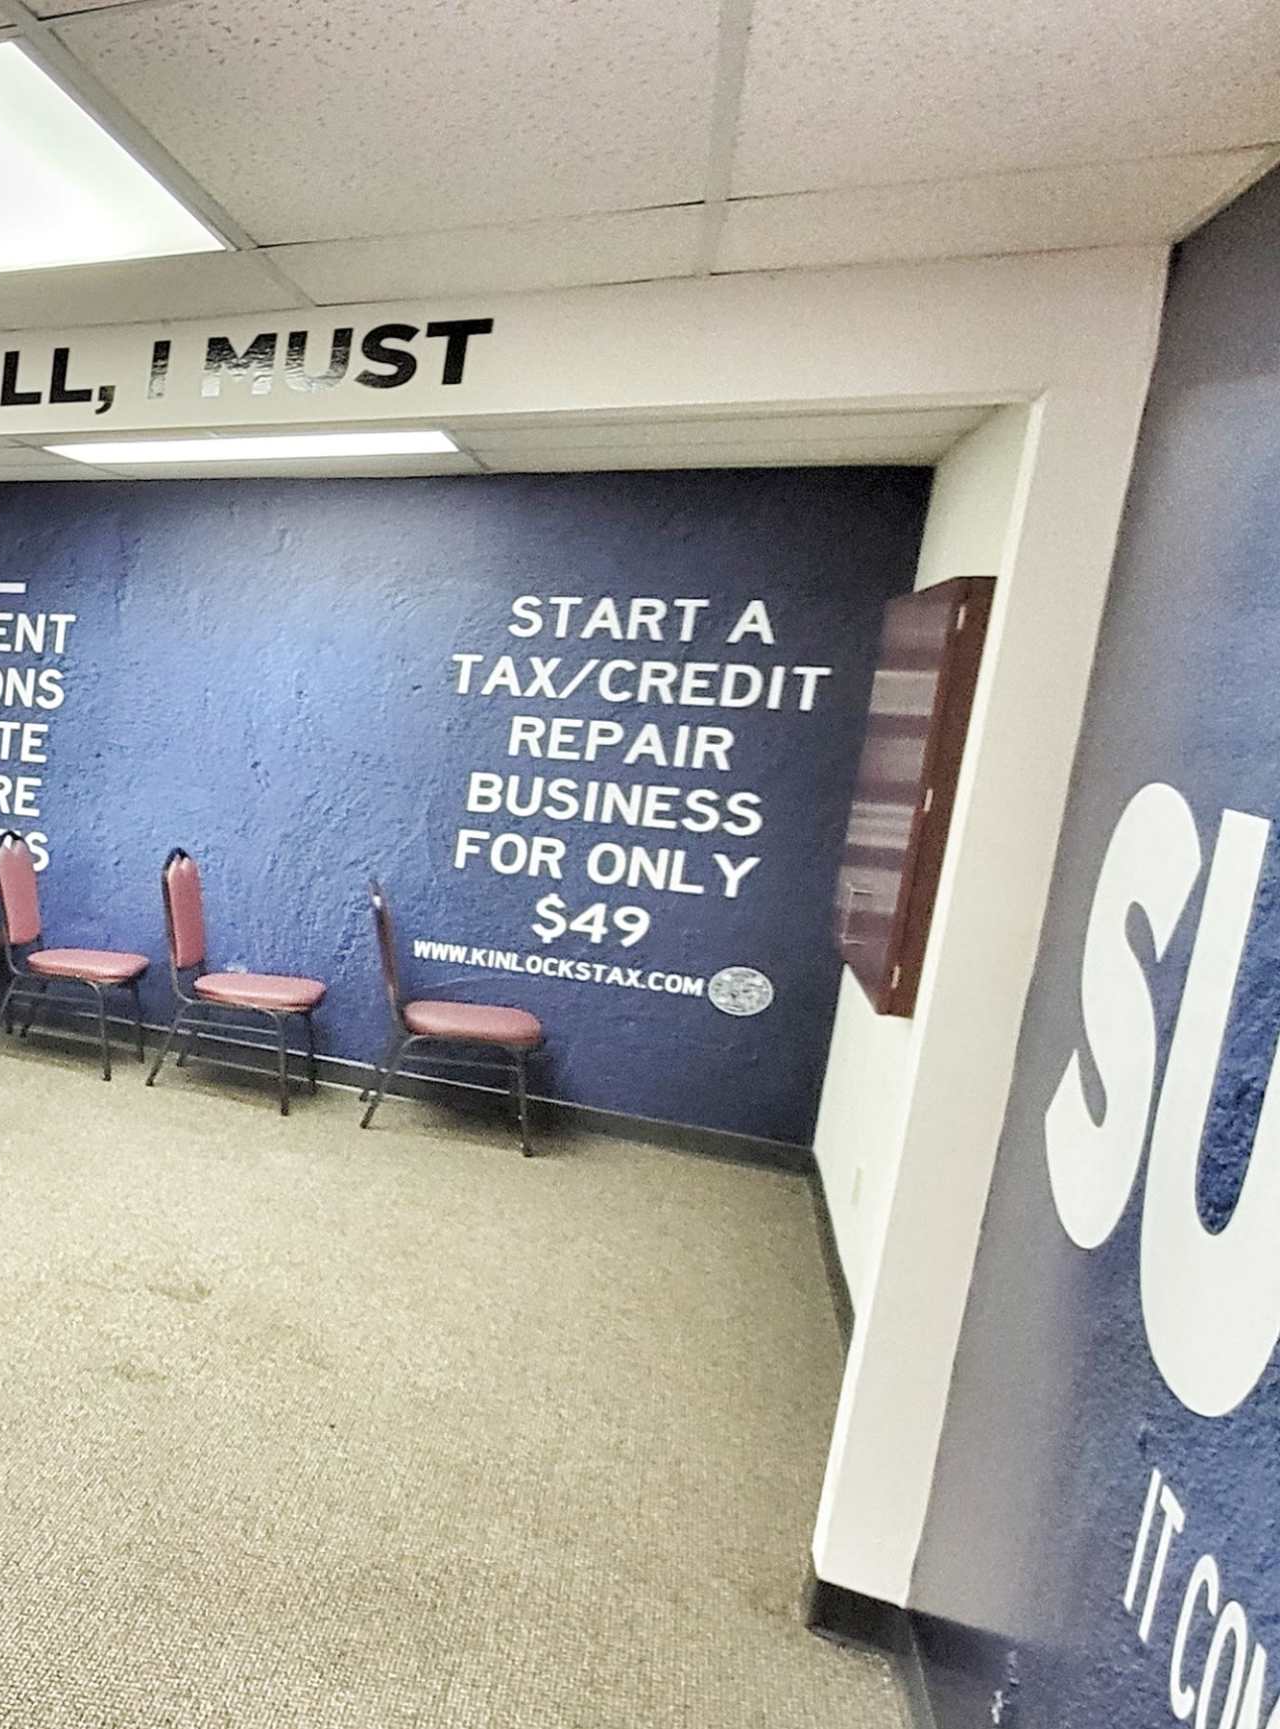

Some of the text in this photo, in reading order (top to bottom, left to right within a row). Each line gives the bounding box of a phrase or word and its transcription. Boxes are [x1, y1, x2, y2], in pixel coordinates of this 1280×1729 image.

[147, 341, 171, 400] I
[200, 318, 495, 399] MUST
[508, 596, 776, 645] START A
[452, 653, 832, 711] TAX/CREDIT
[508, 715, 735, 771] REPAIR
[465, 771, 763, 837] BUSINESS
[453, 828, 761, 899] FOR ONLY
[531, 892, 651, 948] $49
[413, 940, 704, 997] WWW.KINLOCKSTAX.COM
[1124, 1468, 1185, 1644] IT
